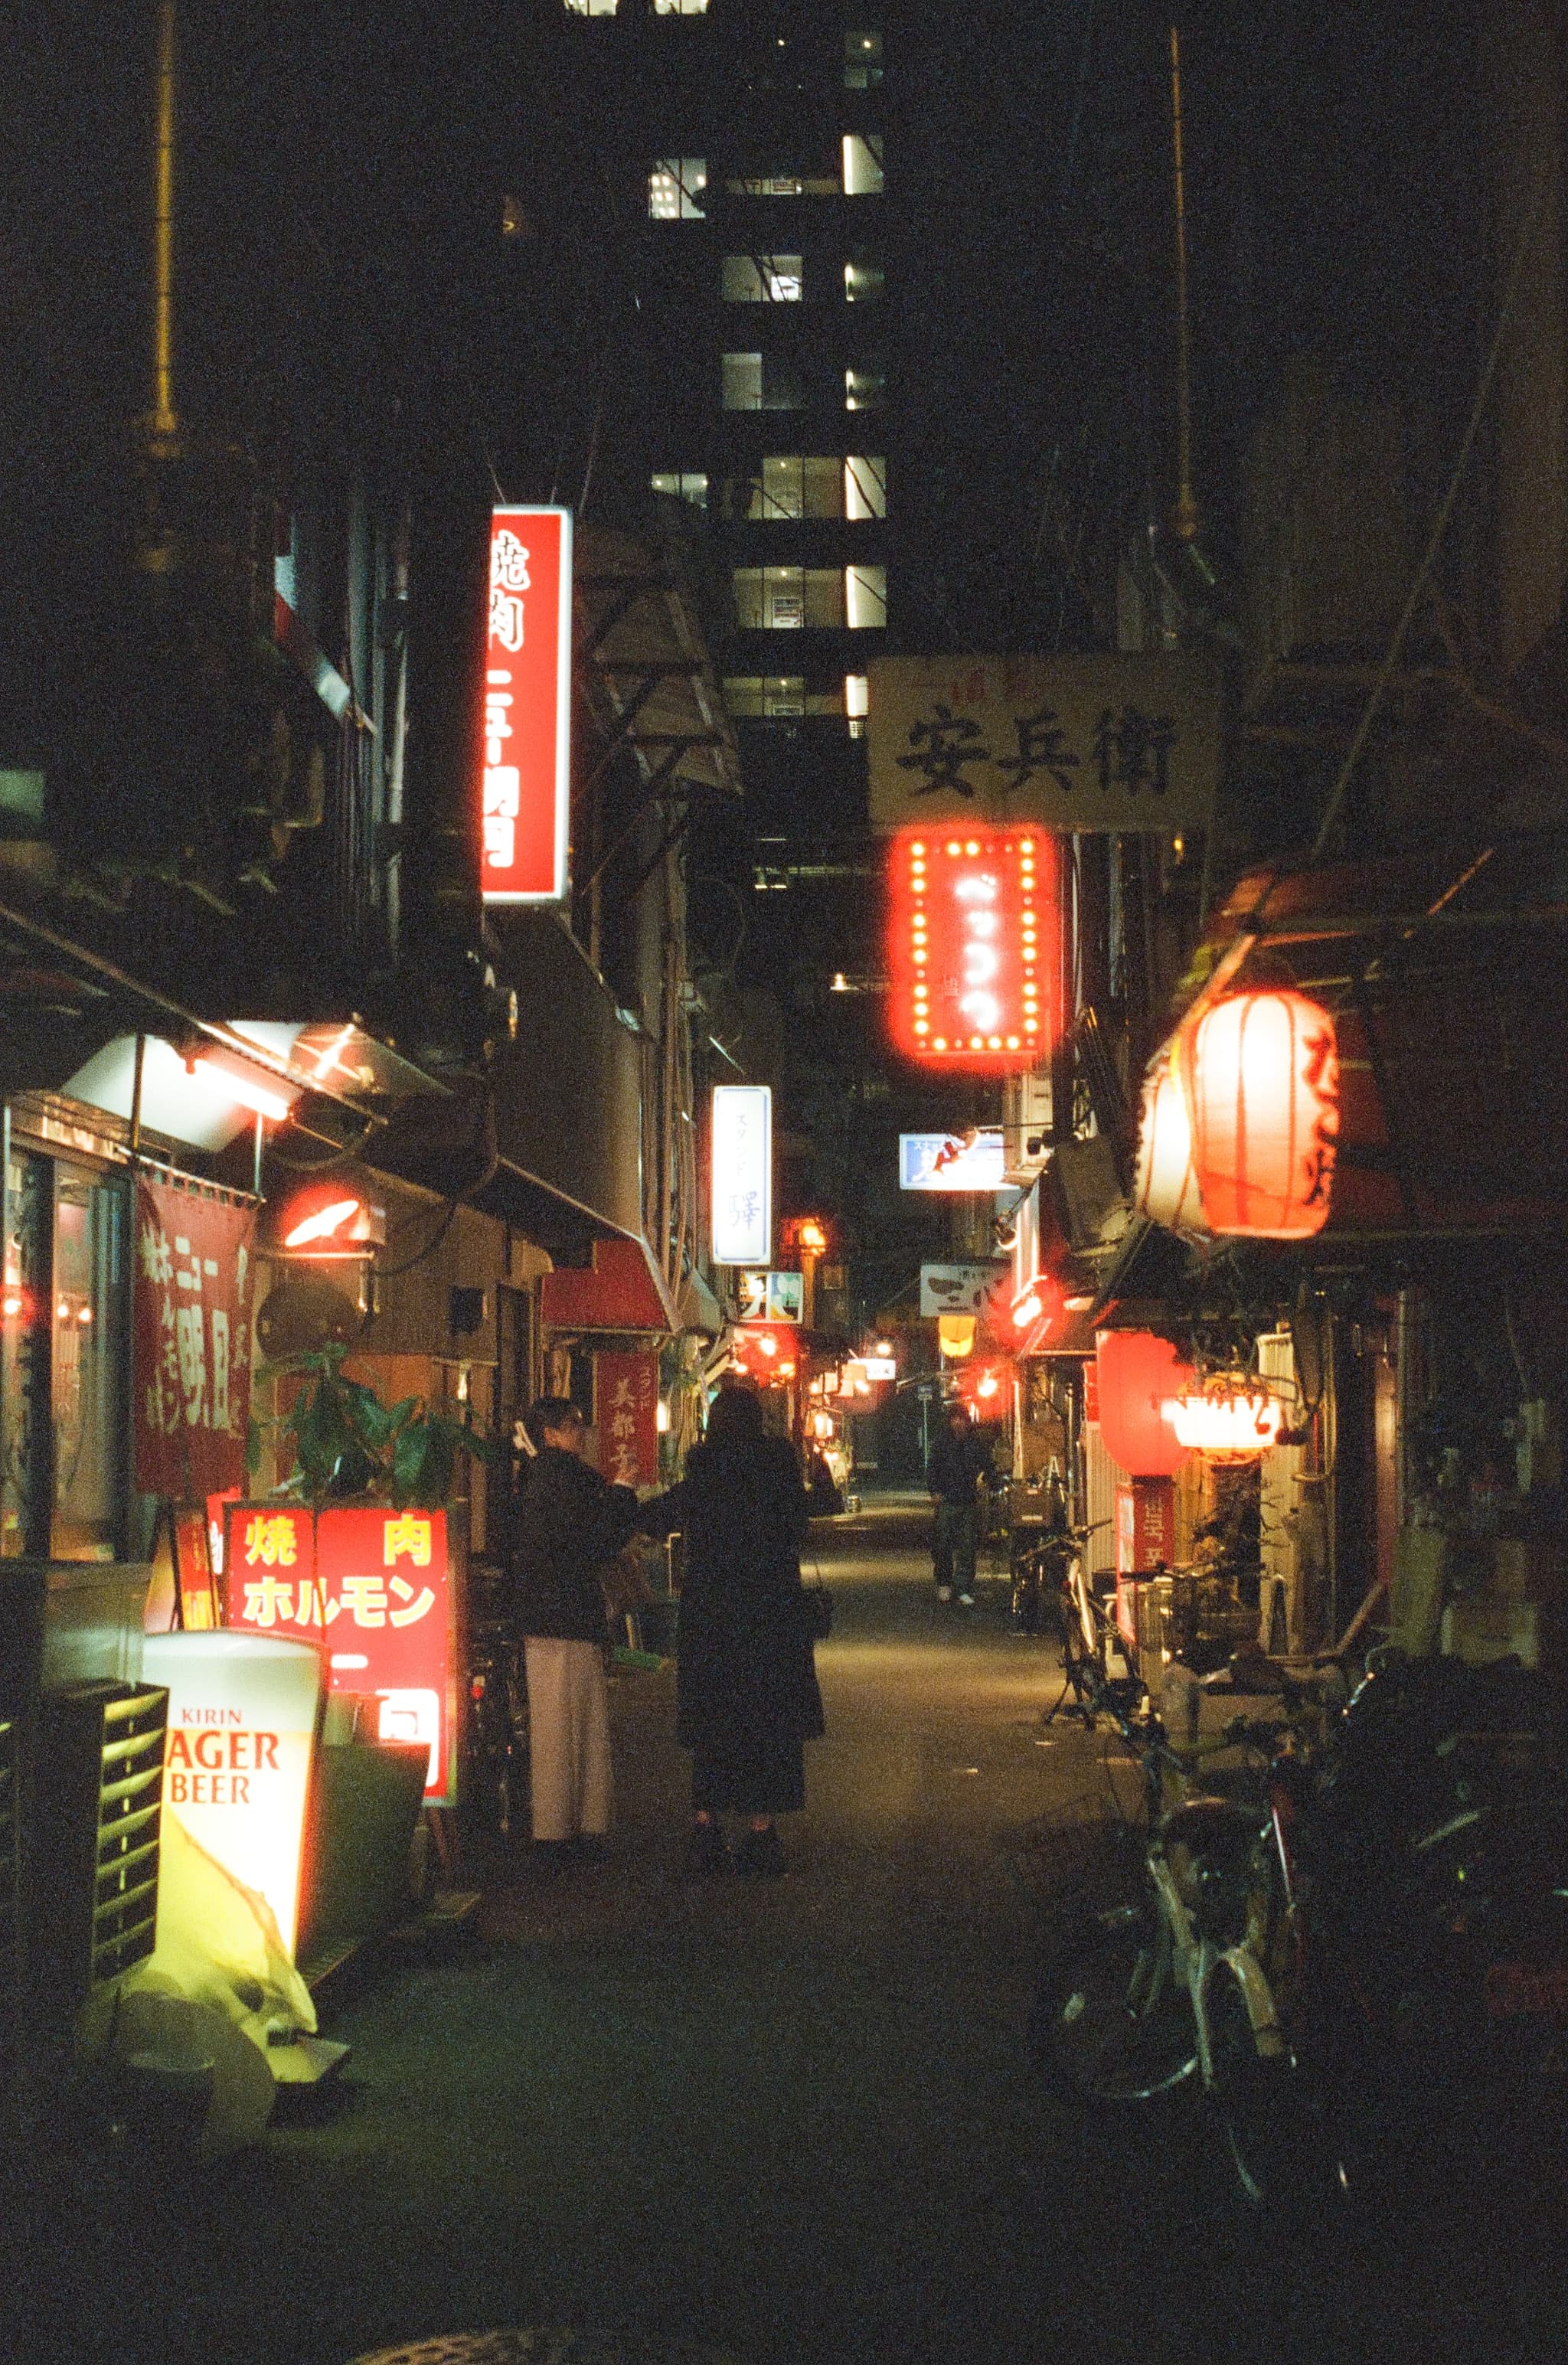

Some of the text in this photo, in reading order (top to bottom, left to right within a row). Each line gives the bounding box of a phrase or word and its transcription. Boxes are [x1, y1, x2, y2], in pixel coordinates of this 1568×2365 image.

[895, 703, 1178, 797] 安兵衛
[735, 1113, 748, 1177] スタンド
[243, 1575, 435, 1628] ホルモン
[181, 1708, 243, 1724] KIRIN
[167, 1730, 280, 1770] AGER
[170, 1772, 250, 1805] BEER
